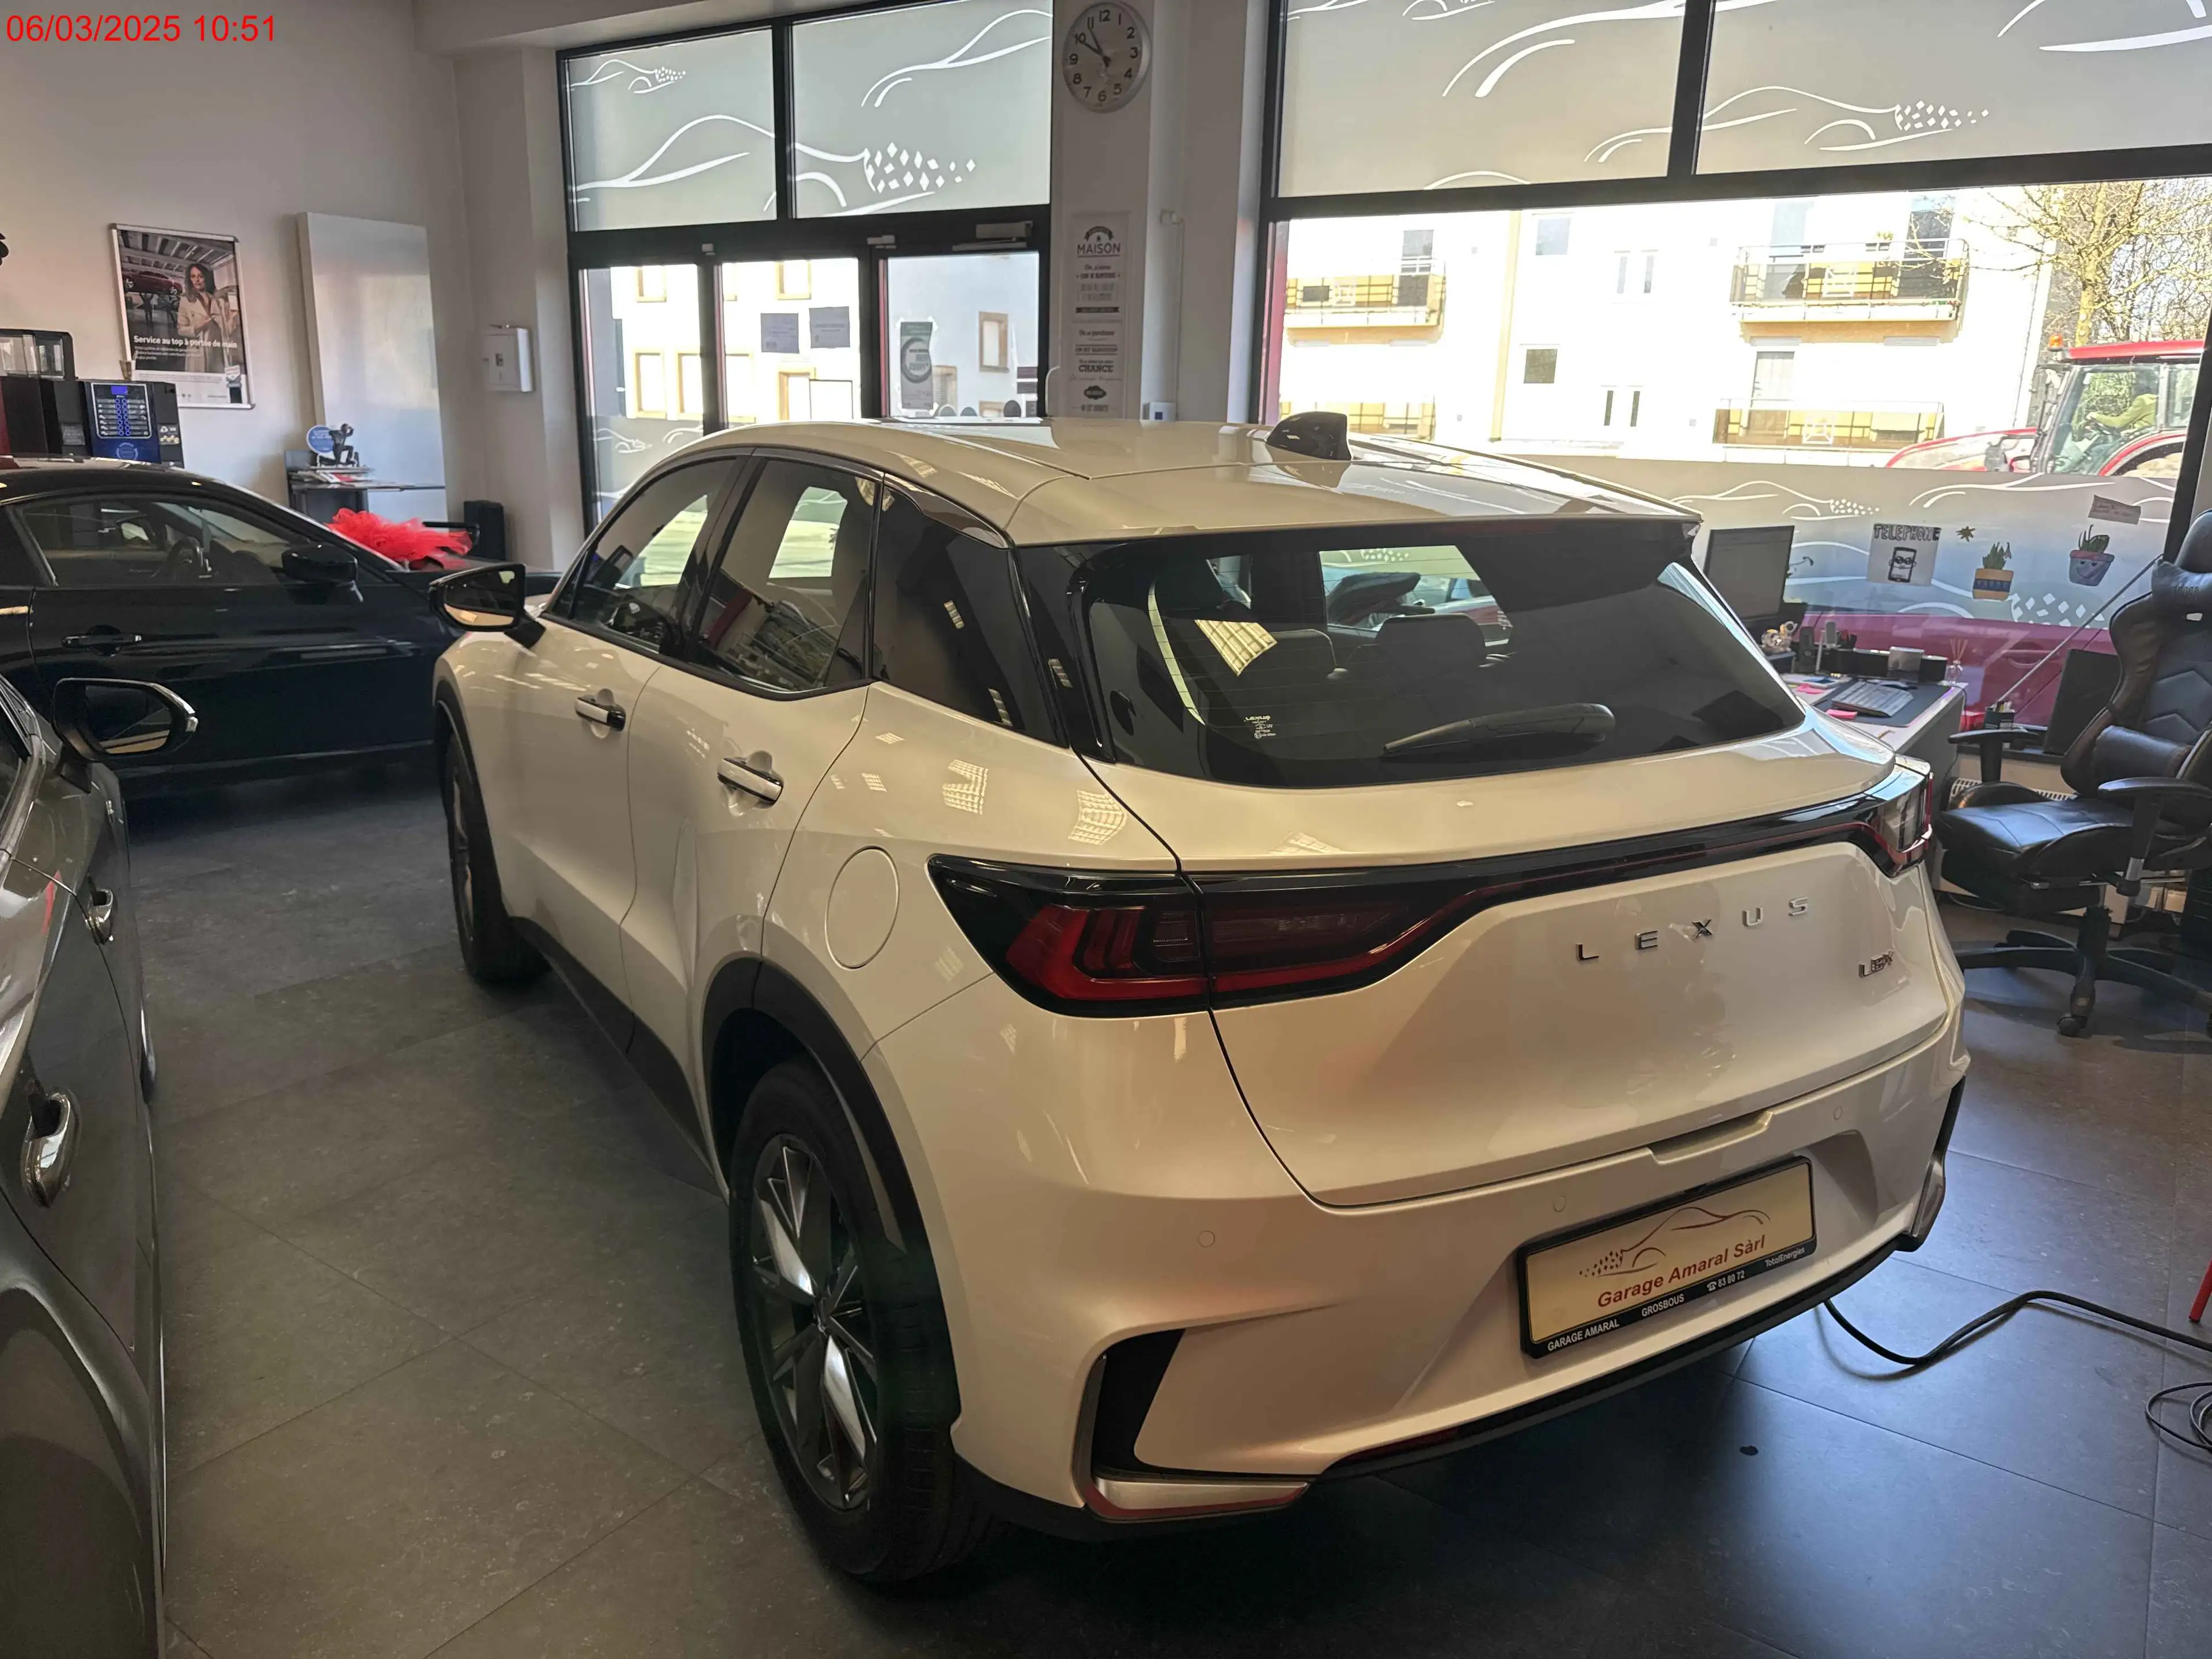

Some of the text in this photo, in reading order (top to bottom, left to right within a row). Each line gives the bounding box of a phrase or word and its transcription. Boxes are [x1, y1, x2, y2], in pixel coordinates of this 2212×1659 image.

[1099, 9, 1111, 22] 12
[1118, 13, 1122, 25] 1
[1126, 26, 1135, 39] 2
[1130, 46, 1138, 59] 3
[1069, 53, 1078, 65] 9
[1073, 73, 1082, 85] 8
[1124, 67, 1132, 79] 4
[1083, 86, 1092, 98] 7
[1113, 83, 1122, 95] 5
[1097, 90, 1107, 101] 6
[1077, 242, 1122, 255] MAISON
[134, 335, 161, 344] Service
[172, 338, 184, 347] top
[1078, 365, 1114, 373] CHANCE
[1575, 896, 1809, 961] LEXUS
[1598, 1234, 1766, 1308] Garage Amaral Sàrl
[1547, 1247, 1805, 1352] GARAGE AMARAL GROSBOUS 83 80 72 TotalEnergies
